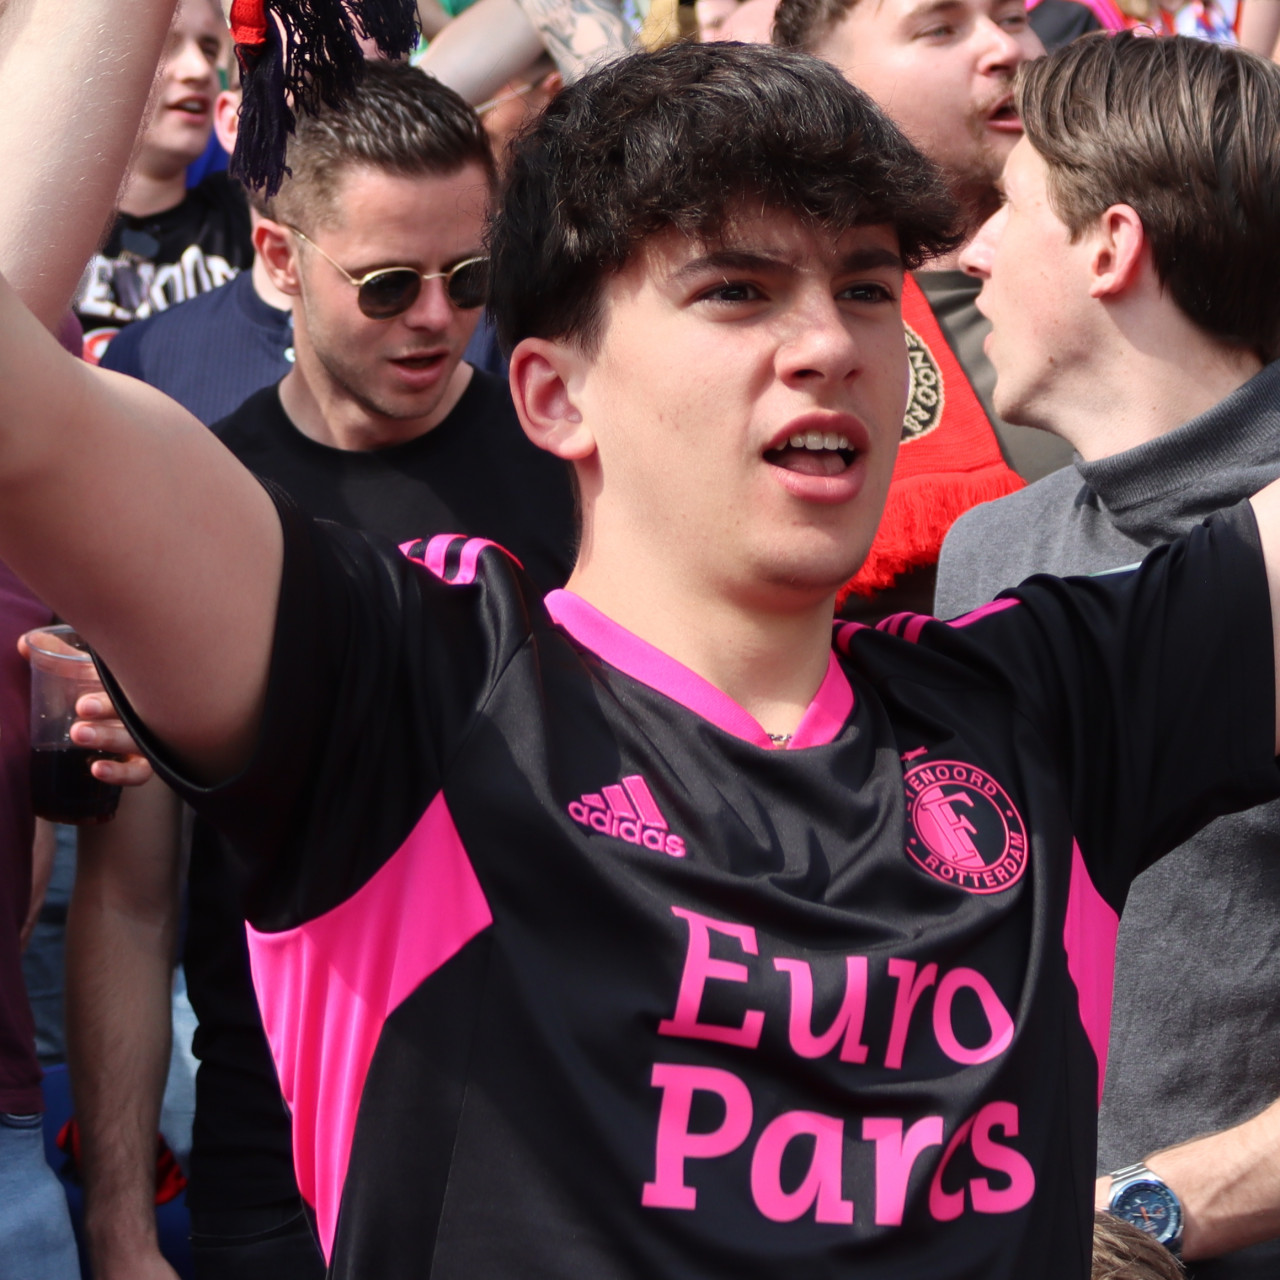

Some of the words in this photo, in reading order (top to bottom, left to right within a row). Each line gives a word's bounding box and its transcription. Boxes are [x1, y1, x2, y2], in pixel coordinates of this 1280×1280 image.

[568, 801, 686, 857] adidas
[925, 831, 1024, 888] ROTTERDAM
[658, 906, 1014, 1069] Euro
[641, 1062, 1036, 1226] Parcs
